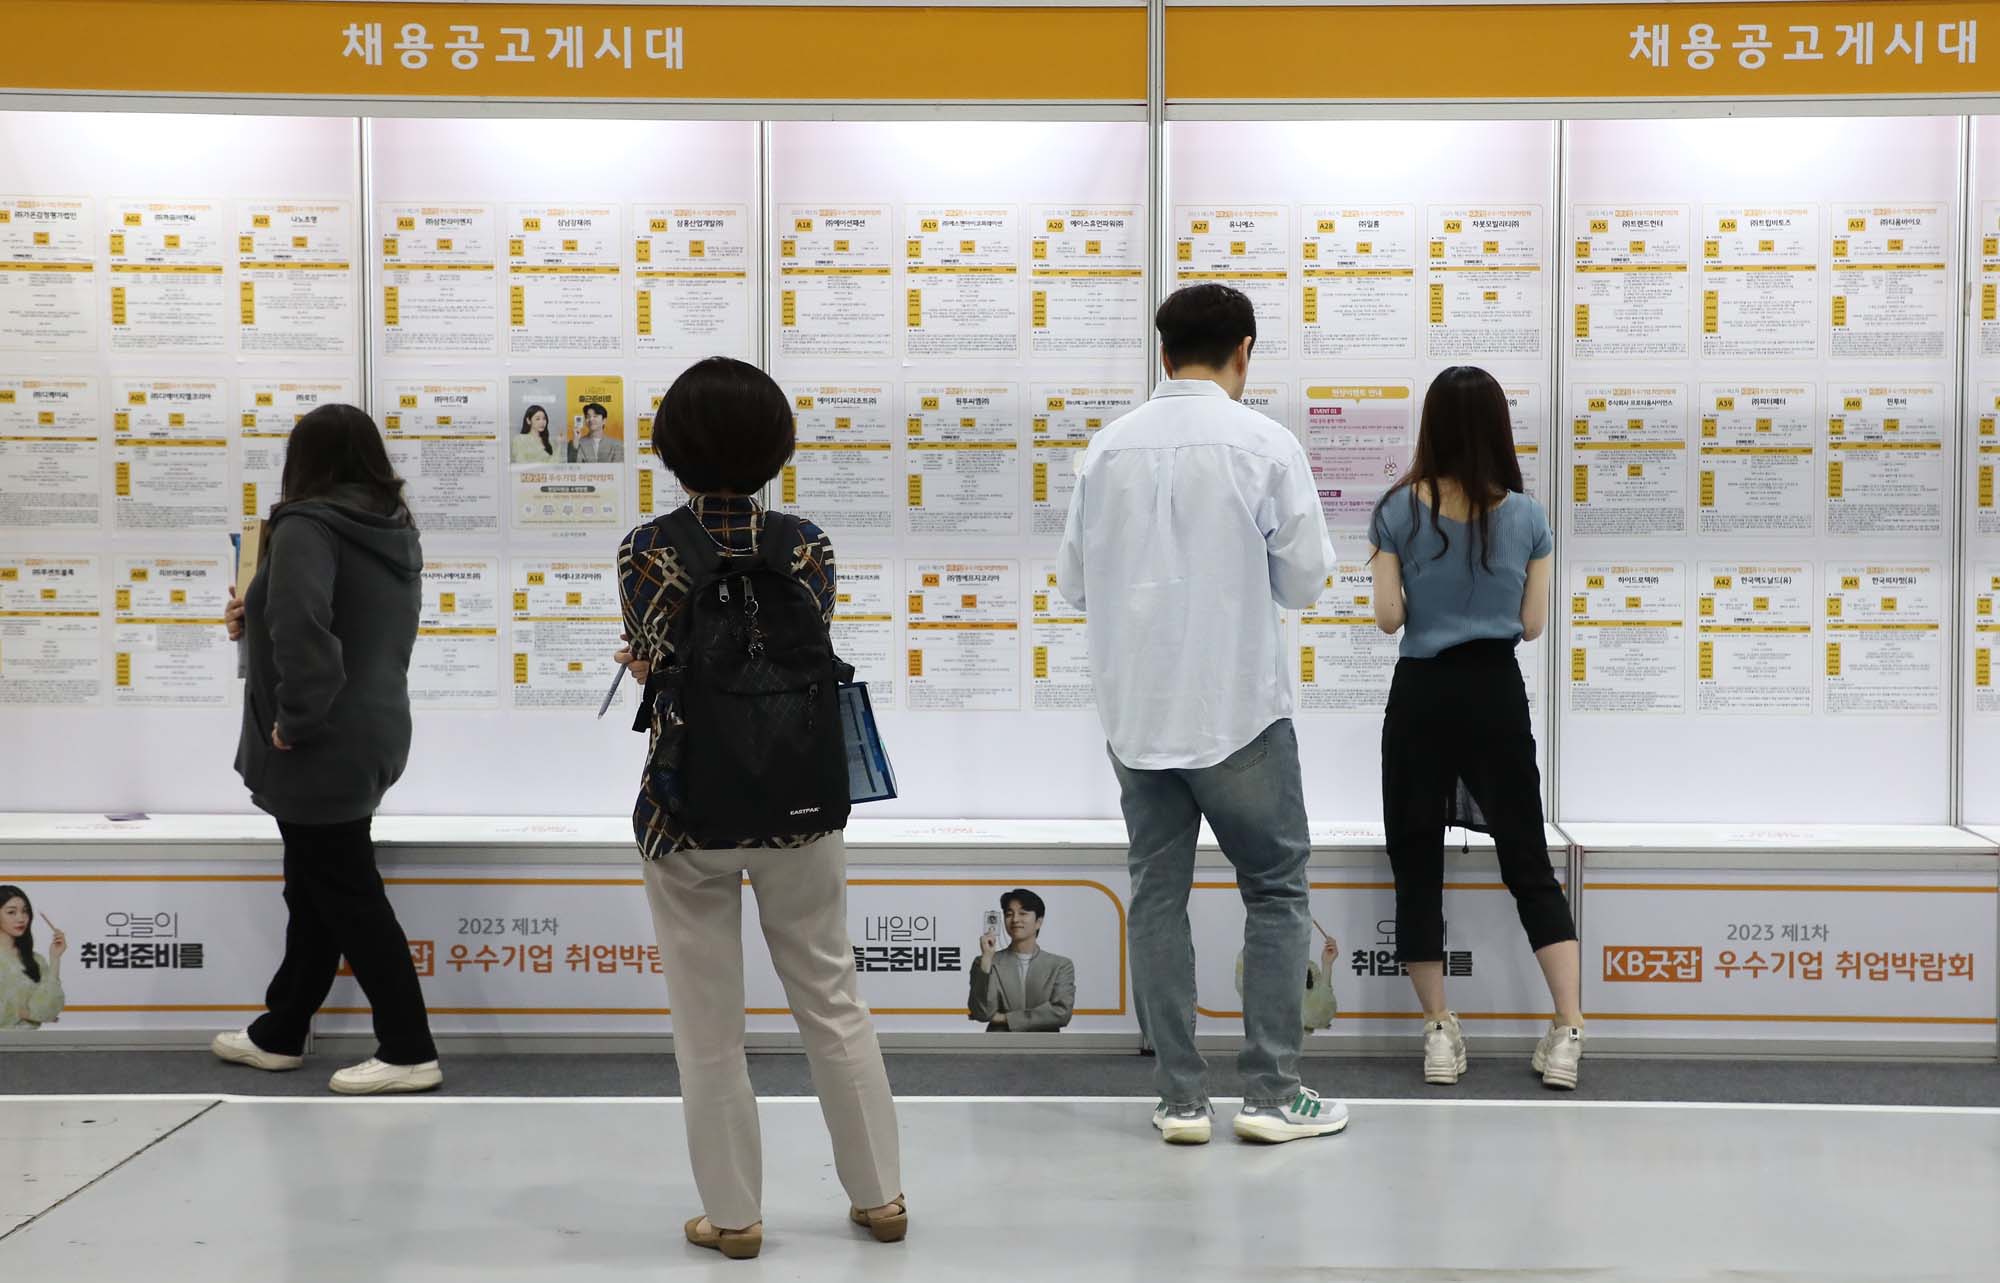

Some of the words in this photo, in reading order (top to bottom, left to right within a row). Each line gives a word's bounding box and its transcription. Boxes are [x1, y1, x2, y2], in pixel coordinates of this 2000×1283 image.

[342, 22, 685, 70] 채용공고게시대
[1629, 20, 1979, 70] 채용공고게시대
[397, 219, 413, 229] A10
[524, 220, 539, 230] A11
[652, 221, 667, 231] A12
[797, 221, 811, 231] A18
[922, 221, 937, 231] A19
[1048, 221, 1063, 231] A20
[1193, 222, 1208, 232] A27
[1319, 222, 1334, 232] A28
[1446, 221, 1461, 231] A29
[1592, 222, 1607, 232] A35
[1721, 221, 1737, 231] A36
[1850, 220, 1866, 230] A37
[402, 397, 417, 407] A13
[797, 399, 811, 408] A21
[923, 399, 937, 409] A22
[1242, 398, 1269, 406] 토모티브
[1590, 400, 1605, 409] A38
[1718, 399, 1733, 409] A39
[1847, 399, 1862, 409] A40
[528, 574, 543, 583] A16
[924, 576, 939, 586] A25
[1340, 575, 1375, 584] 코넥시오에
[1587, 577, 1603, 587] A41
[1716, 578, 1731, 587] A42
[1844, 578, 1859, 587] A43
[106, 911, 178, 939] 오늘의
[457, 917, 506, 936] 2023
[511, 917, 559, 937] 제1차
[865, 916, 937, 943] 내일의
[1726, 924, 1776, 942] 2023
[1781, 923, 1831, 943] 제1차
[80, 942, 204, 969] 취업준비를
[445, 944, 553, 975] 우수기업
[564, 944, 664, 975] 취업박람
[1351, 950, 1473, 977] 취업를
[1605, 950, 1702, 979] KB굿잡
[1713, 951, 1823, 981] 우수기업
[1835, 951, 1974, 983] 취업박람회
